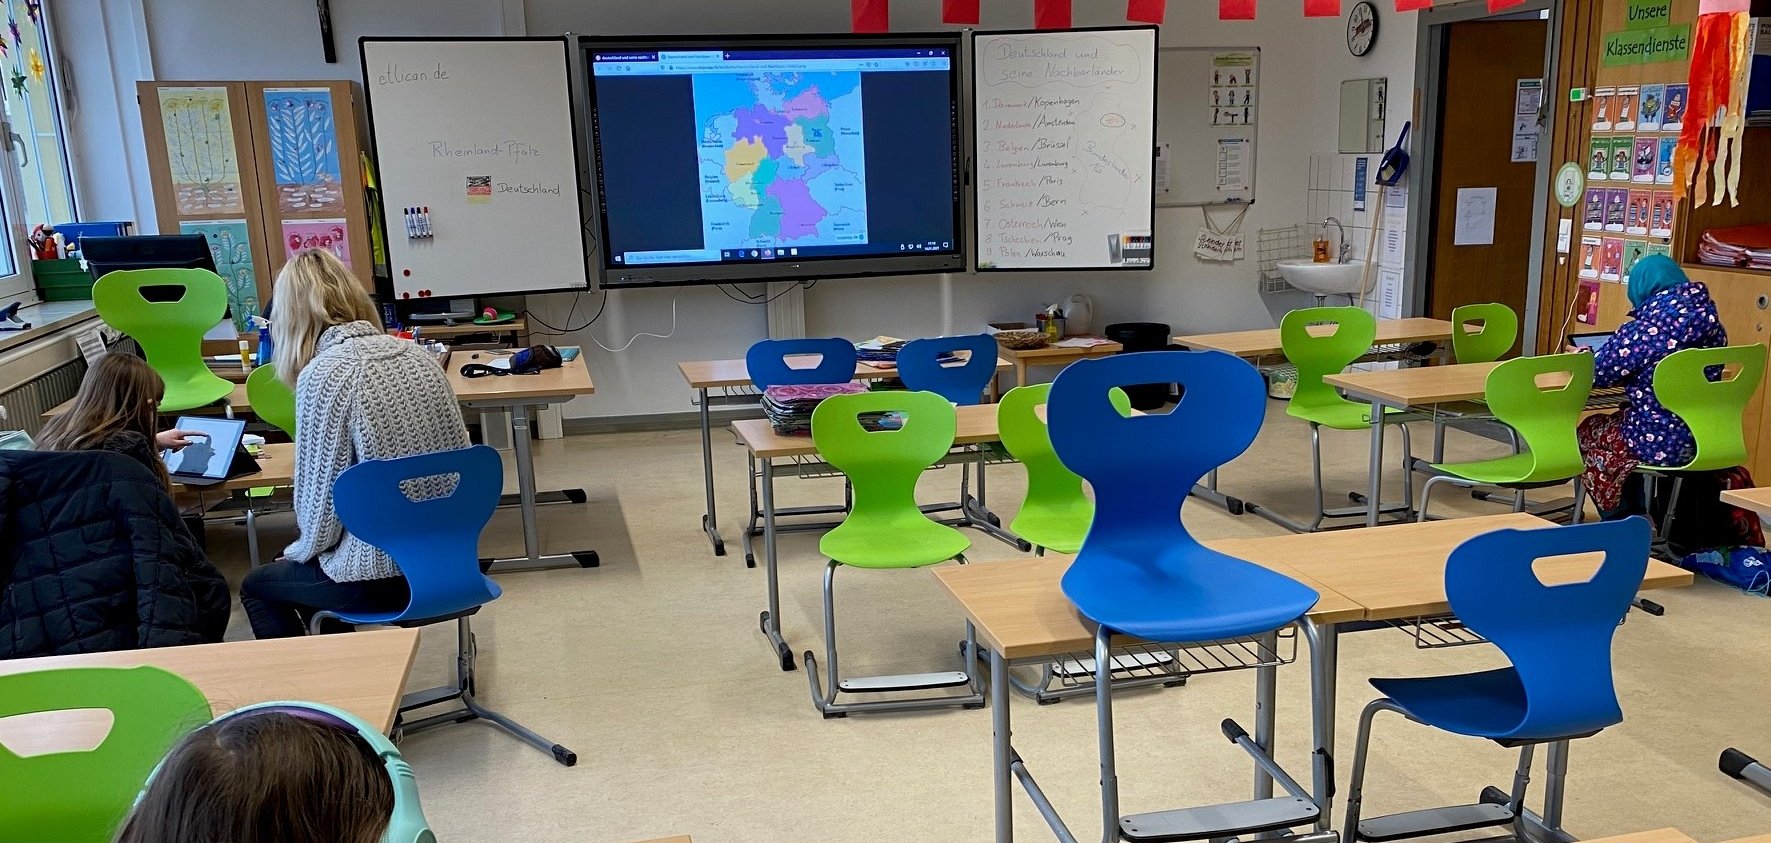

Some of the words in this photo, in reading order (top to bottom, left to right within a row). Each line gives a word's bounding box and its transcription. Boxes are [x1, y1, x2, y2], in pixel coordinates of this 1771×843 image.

[1629, 4, 1667, 21] Unsere
[995, 43, 1066, 60] Deutschland
[1075, 48, 1098, 59] und
[1606, 34, 1686, 57] Klassendienste
[999, 69, 1033, 81] seine
[429, 140, 542, 164] Rheinland-Pfalz
[497, 182, 561, 196] Deutschland
